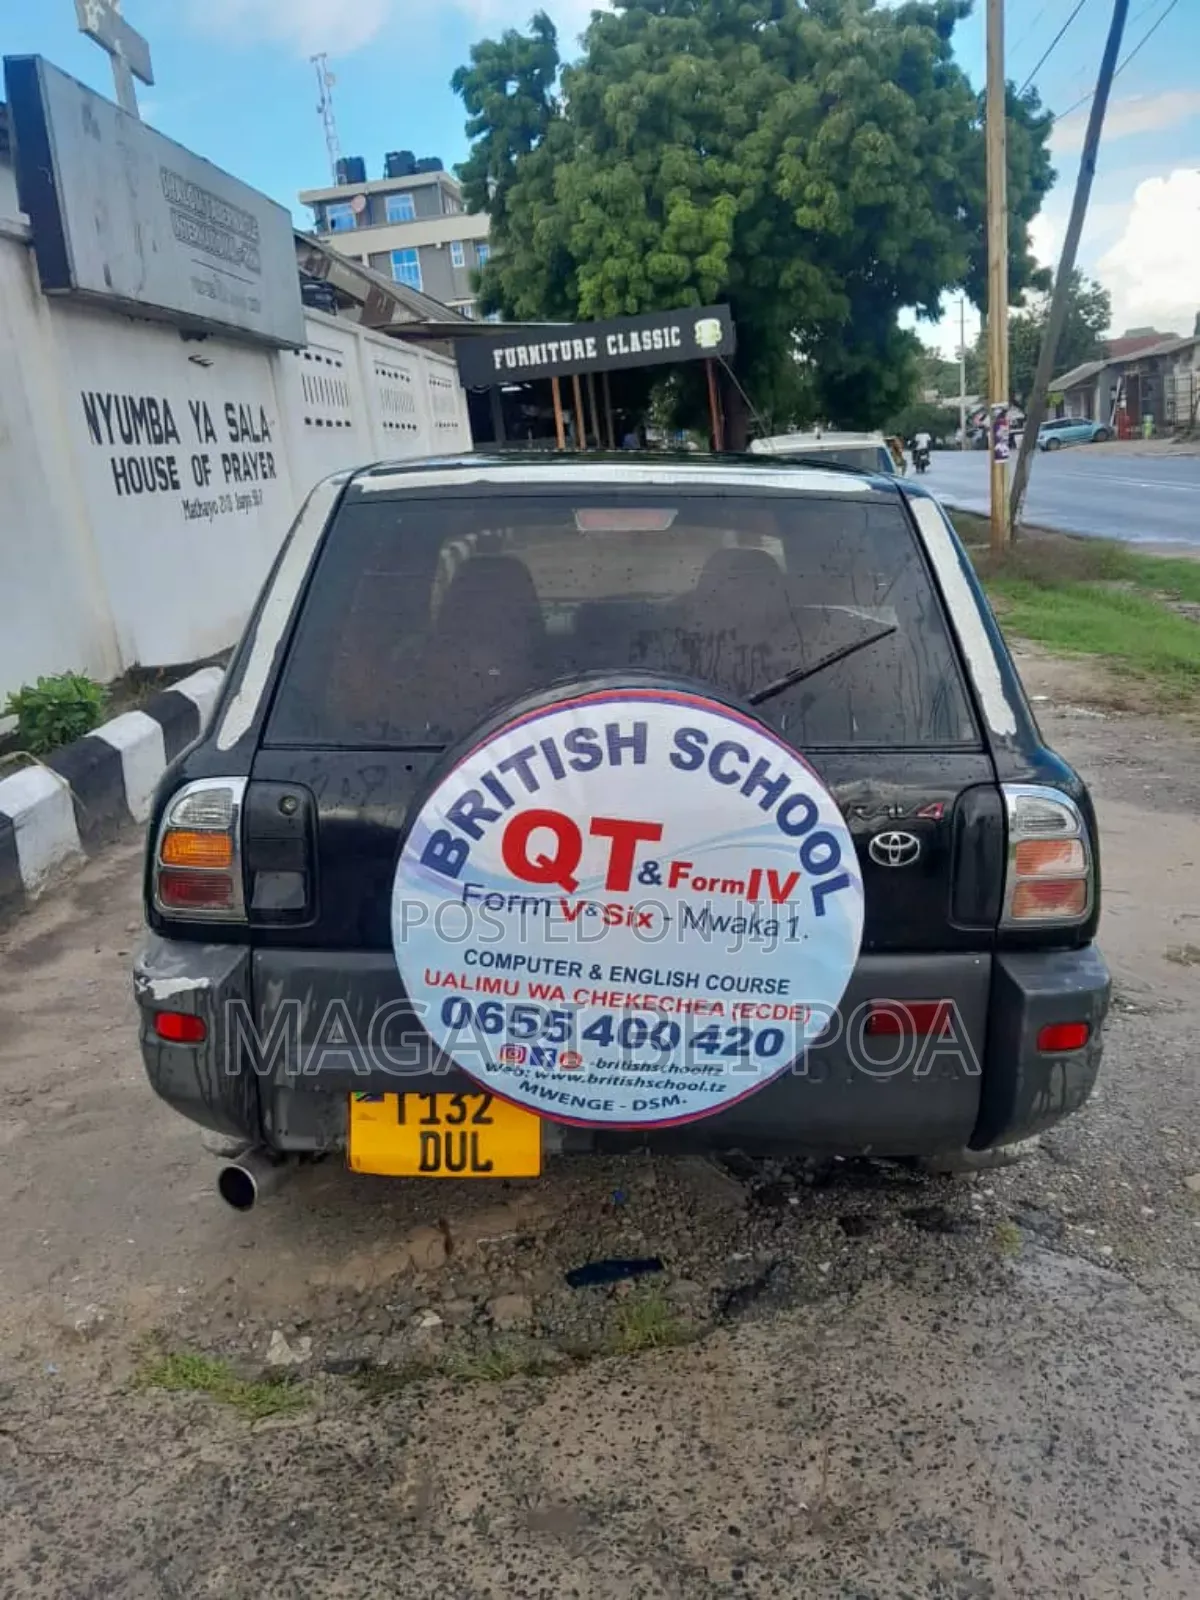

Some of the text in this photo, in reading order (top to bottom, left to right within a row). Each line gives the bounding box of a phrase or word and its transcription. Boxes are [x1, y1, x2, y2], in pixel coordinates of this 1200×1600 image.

[493, 326, 682, 369] FURNITURE CLASSIC
[81, 390, 272, 445] NYUMBA YA SALA
[111, 451, 277, 496] HOUSE OF PRAYER
[420, 722, 850, 917] BRITISH SCHOOL
[502, 808, 801, 905] QT & Form IV
[461, 882, 550, 917] Form
[560, 897, 585, 922] V
[602, 903, 653, 929] Six
[683, 906, 778, 938] Mwaka
[464, 949, 790, 995] COMPUTER & ENGLISH COURSE
[424, 968, 811, 1024] UALIMU WA CHEKECHEA (ECDE)
[441, 996, 785, 1057] 0655 400 420
[519, 1079, 614, 1112] MWENGE
[632, 1094, 688, 1112] DSM.
[535, 1067, 727, 1093] www.britishschool.tz
[418, 1093, 493, 1126] 132
[418, 1130, 493, 1172] DUL
